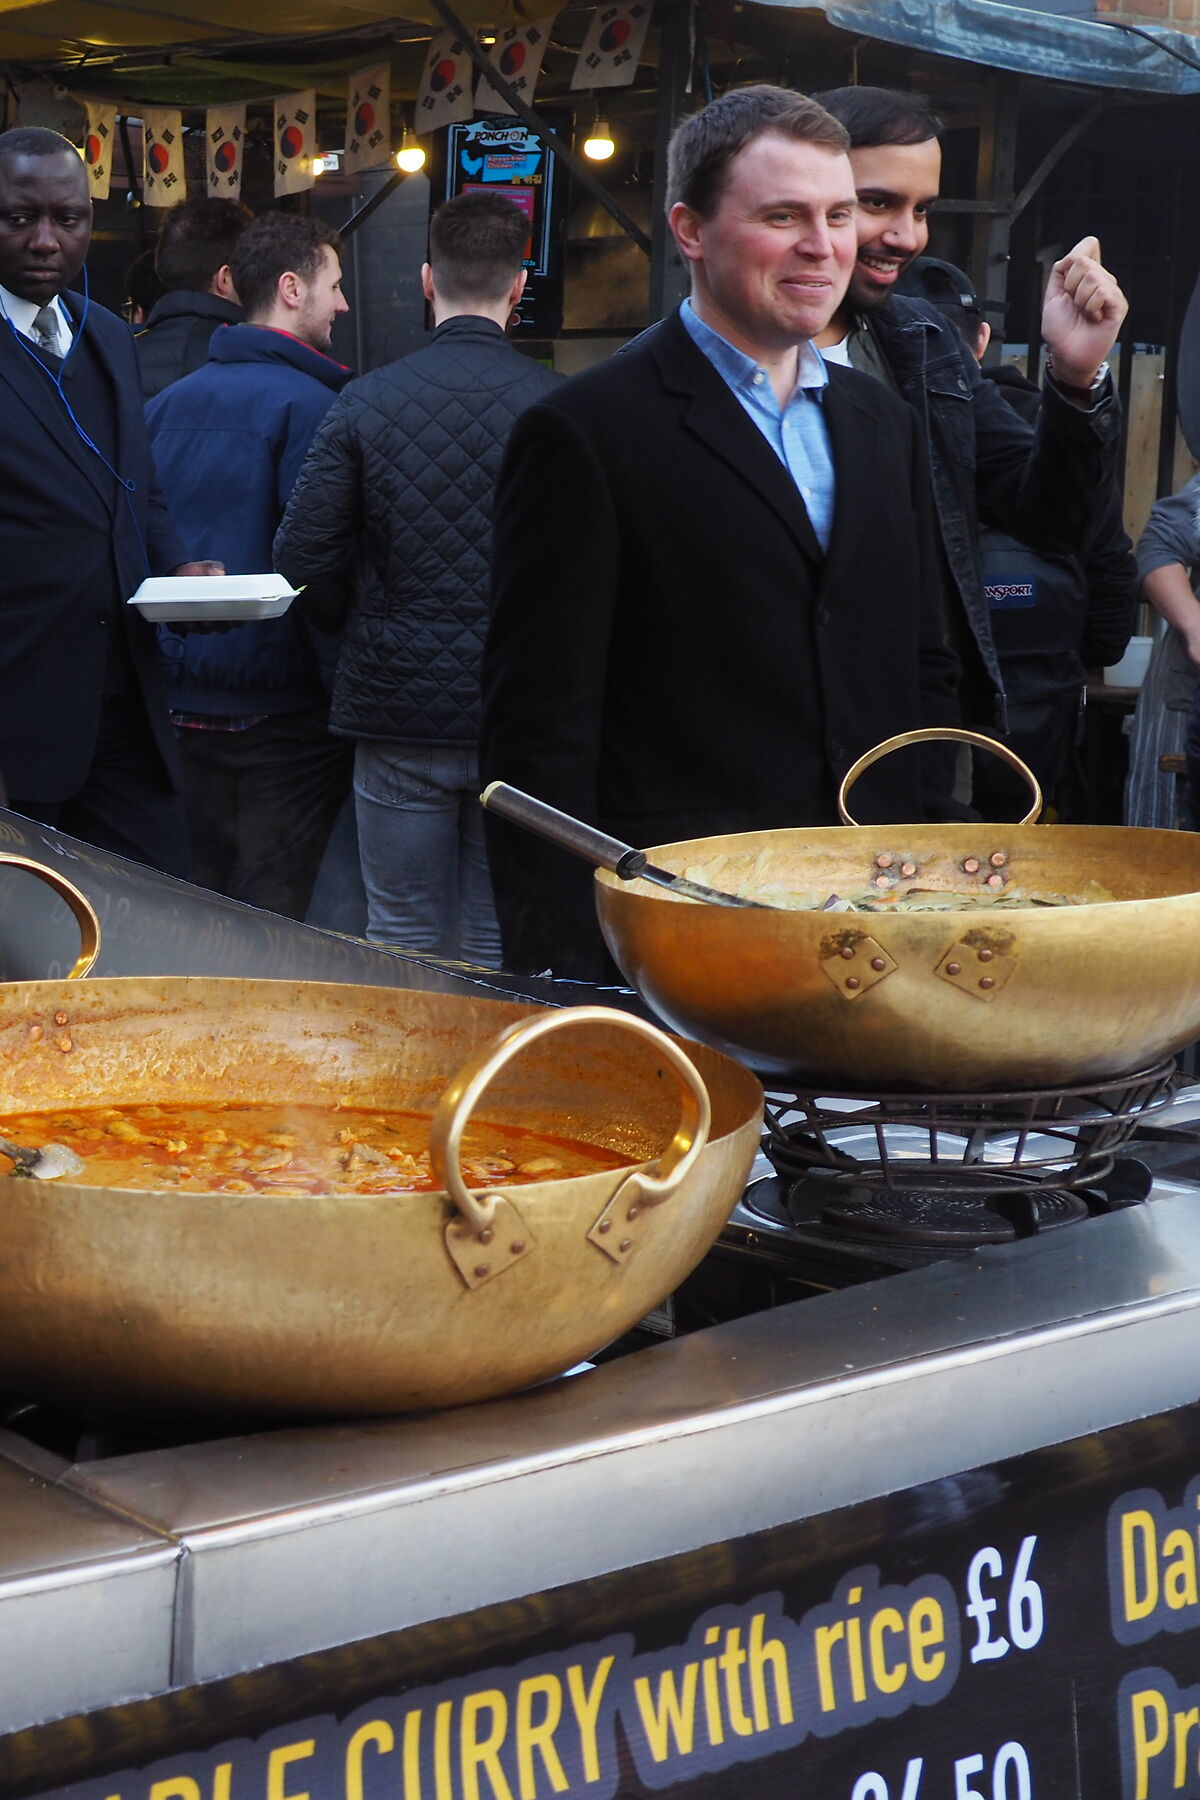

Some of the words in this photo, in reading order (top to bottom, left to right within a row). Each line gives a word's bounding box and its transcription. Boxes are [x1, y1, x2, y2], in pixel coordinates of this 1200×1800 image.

[474, 131, 529, 141] PONCHON
[984, 584, 1033, 600] NSPORT
[635, 1612, 794, 1763] with
[816, 1586, 946, 1712] rice
[966, 1535, 1043, 1664] £6
[1131, 1689, 1200, 1800] Pr
